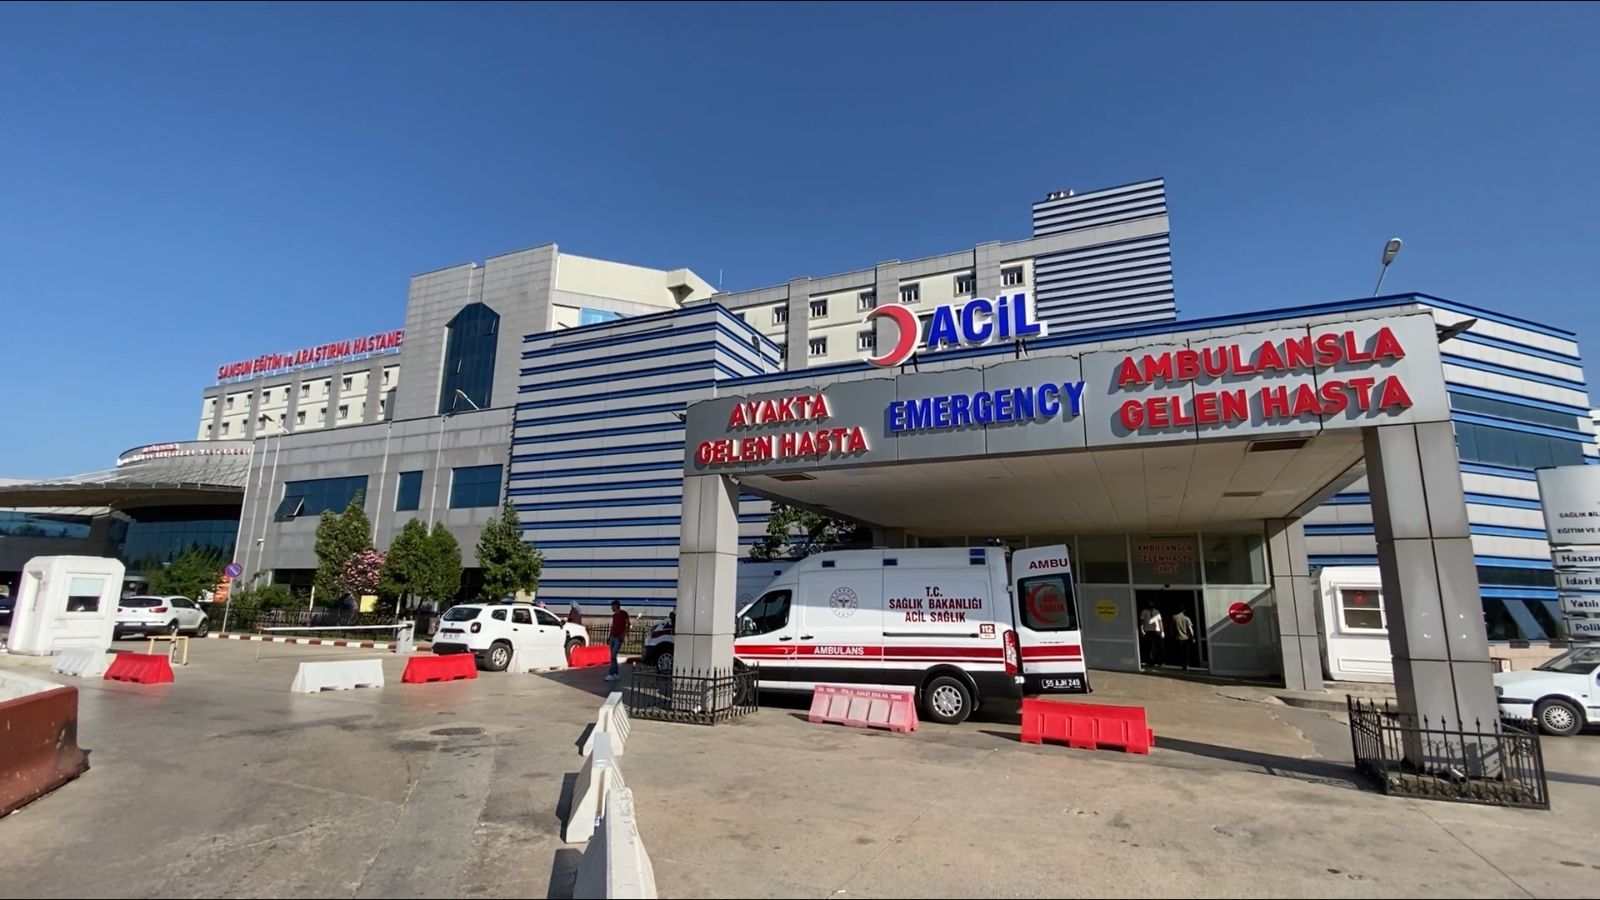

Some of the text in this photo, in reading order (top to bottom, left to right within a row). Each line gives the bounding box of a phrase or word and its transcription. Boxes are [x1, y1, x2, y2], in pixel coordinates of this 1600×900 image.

[927, 292, 1044, 350] ACİL
[217, 360, 252, 380] SAMSUN
[253, 353, 282, 373] EĞİTİM
[283, 355, 293, 367] ve
[295, 341, 351, 365] ARAŞTIRMA
[1118, 326, 1406, 388] AMBULANSLA
[889, 380, 1086, 432] EMERGENCY
[1120, 374, 1414, 430] GELEN HASTA
[729, 393, 830, 428] AYAKTA
[696, 426, 869, 464] GELEN HASTA
[1029, 558, 1068, 570] AMBU
[1566, 577, 1592, 585] İdari
[925, 586, 943, 597] T.C.
[889, 597, 982, 610] SAĞLIK BAKANLIĞI
[1570, 600, 1599, 608] Yatılı
[905, 610, 966, 622] ACİL SAĞLIK
[981, 625, 994, 633] 112
[813, 646, 865, 655] AMBULANS
